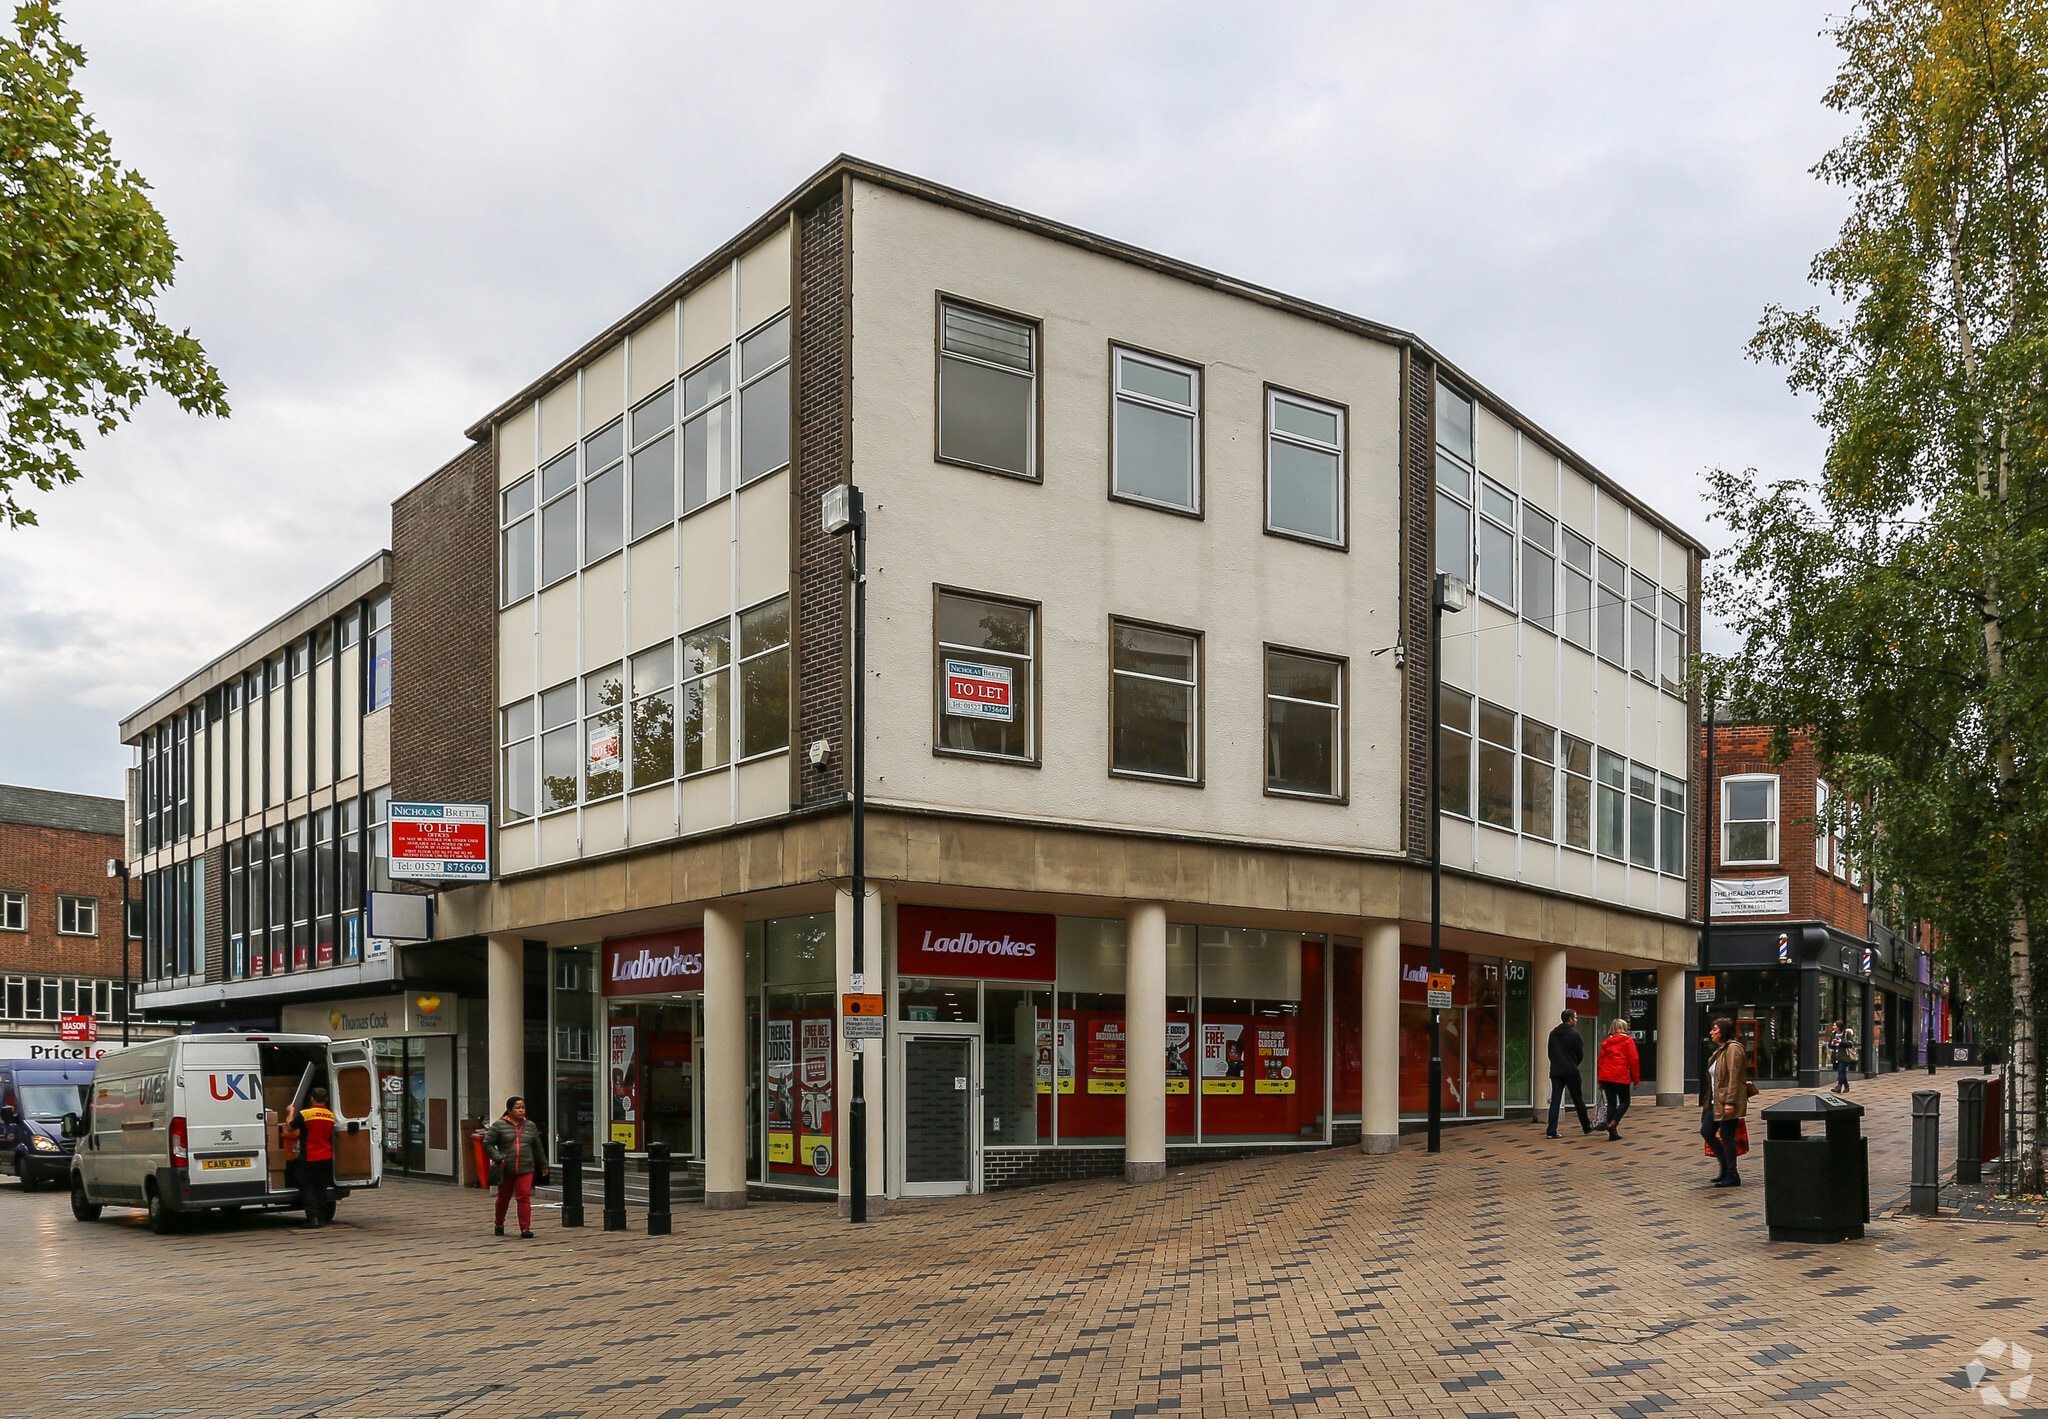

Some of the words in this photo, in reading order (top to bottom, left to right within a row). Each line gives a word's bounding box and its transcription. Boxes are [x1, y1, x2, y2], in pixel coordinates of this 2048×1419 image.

[950, 664, 981, 675] NICHOLAS
[984, 670, 1002, 678] BRETT
[955, 682, 974, 696] TO
[978, 685, 1004, 699] LET
[394, 806, 442, 817] NICHOLAS
[445, 808, 476, 817] BRETT
[417, 823, 433, 833] TO
[438, 824, 460, 833] LET
[396, 862, 412, 870] Tel:
[415, 862, 441, 870] 01527
[447, 863, 483, 872] 875669
[922, 930, 1036, 957] Ladbrokes
[612, 946, 702, 981] Ladbrokes
[1566, 983, 1590, 1000] brokes
[341, 1014, 368, 1030] Thomas
[370, 1011, 388, 1028] Cook
[768, 1024, 790, 1040] TREBLE
[805, 1025, 817, 1036] FREE
[818, 1025, 828, 1036] BET
[1096, 1032, 1126, 1040] INSURANCE
[1171, 1026, 1186, 1034] ODDS
[1258, 1031, 1270, 1039] THIS
[1271, 1032, 1285, 1040] SHOP
[612, 1035, 626, 1049] FREE
[803, 1037, 810, 1048] UP
[811, 1037, 817, 1048] TO
[1205, 1032, 1224, 1044] FREE
[30, 1045, 112, 1060] PriceLe
[612, 1050, 624, 1064] BET
[1205, 1046, 1221, 1058] BET
[1259, 1048, 1272, 1056] 10PM
[1273, 1048, 1289, 1056] TODAY
[207, 1160, 227, 1168] CA16
[229, 1159, 246, 1168] VZB
